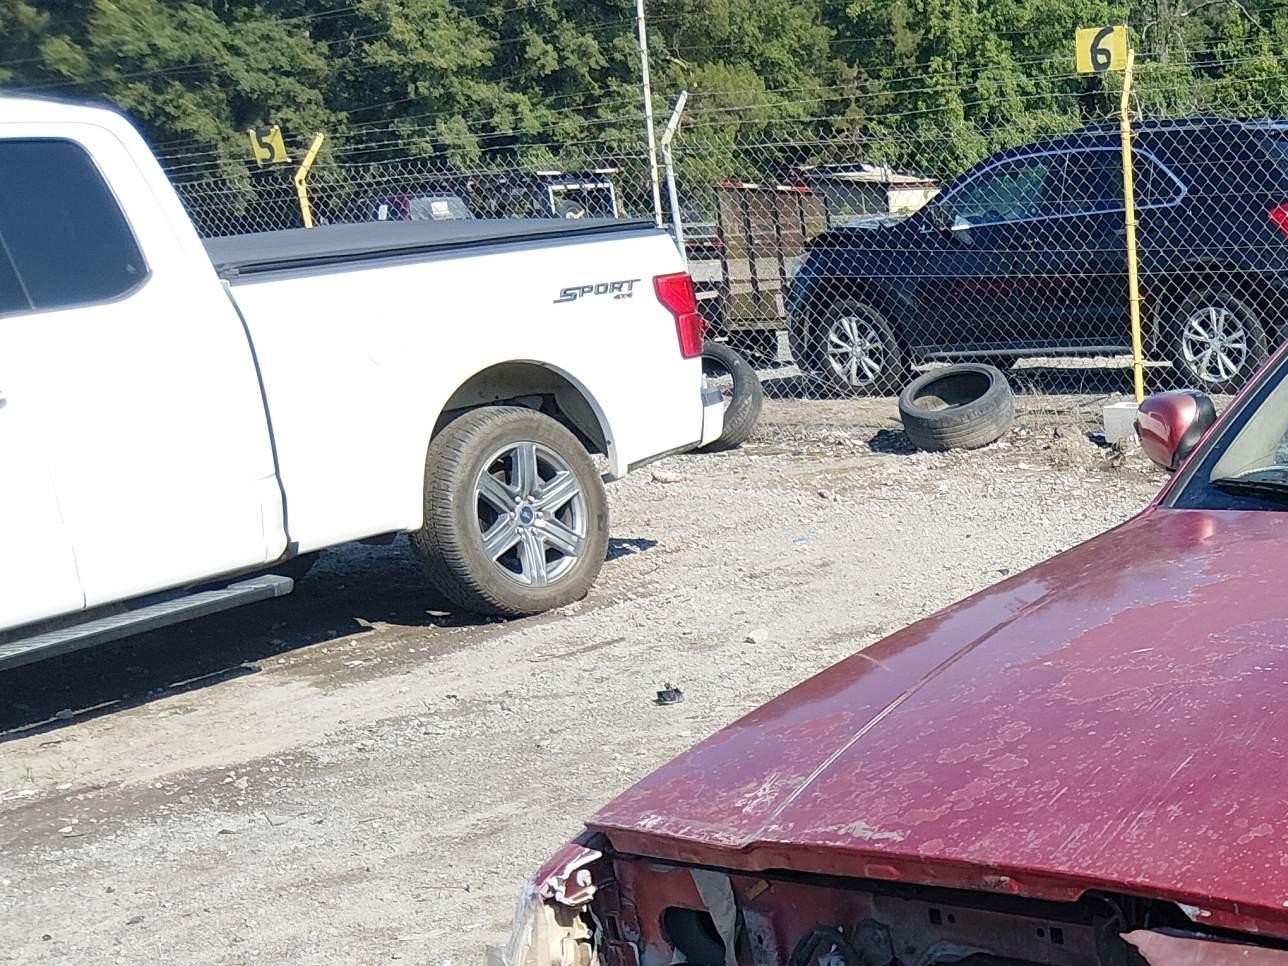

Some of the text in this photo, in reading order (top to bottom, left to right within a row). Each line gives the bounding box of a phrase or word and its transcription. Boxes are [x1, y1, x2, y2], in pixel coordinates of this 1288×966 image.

[1090, 26, 1115, 72] 6
[255, 127, 276, 164] 5
[553, 278, 641, 304] SPORT
